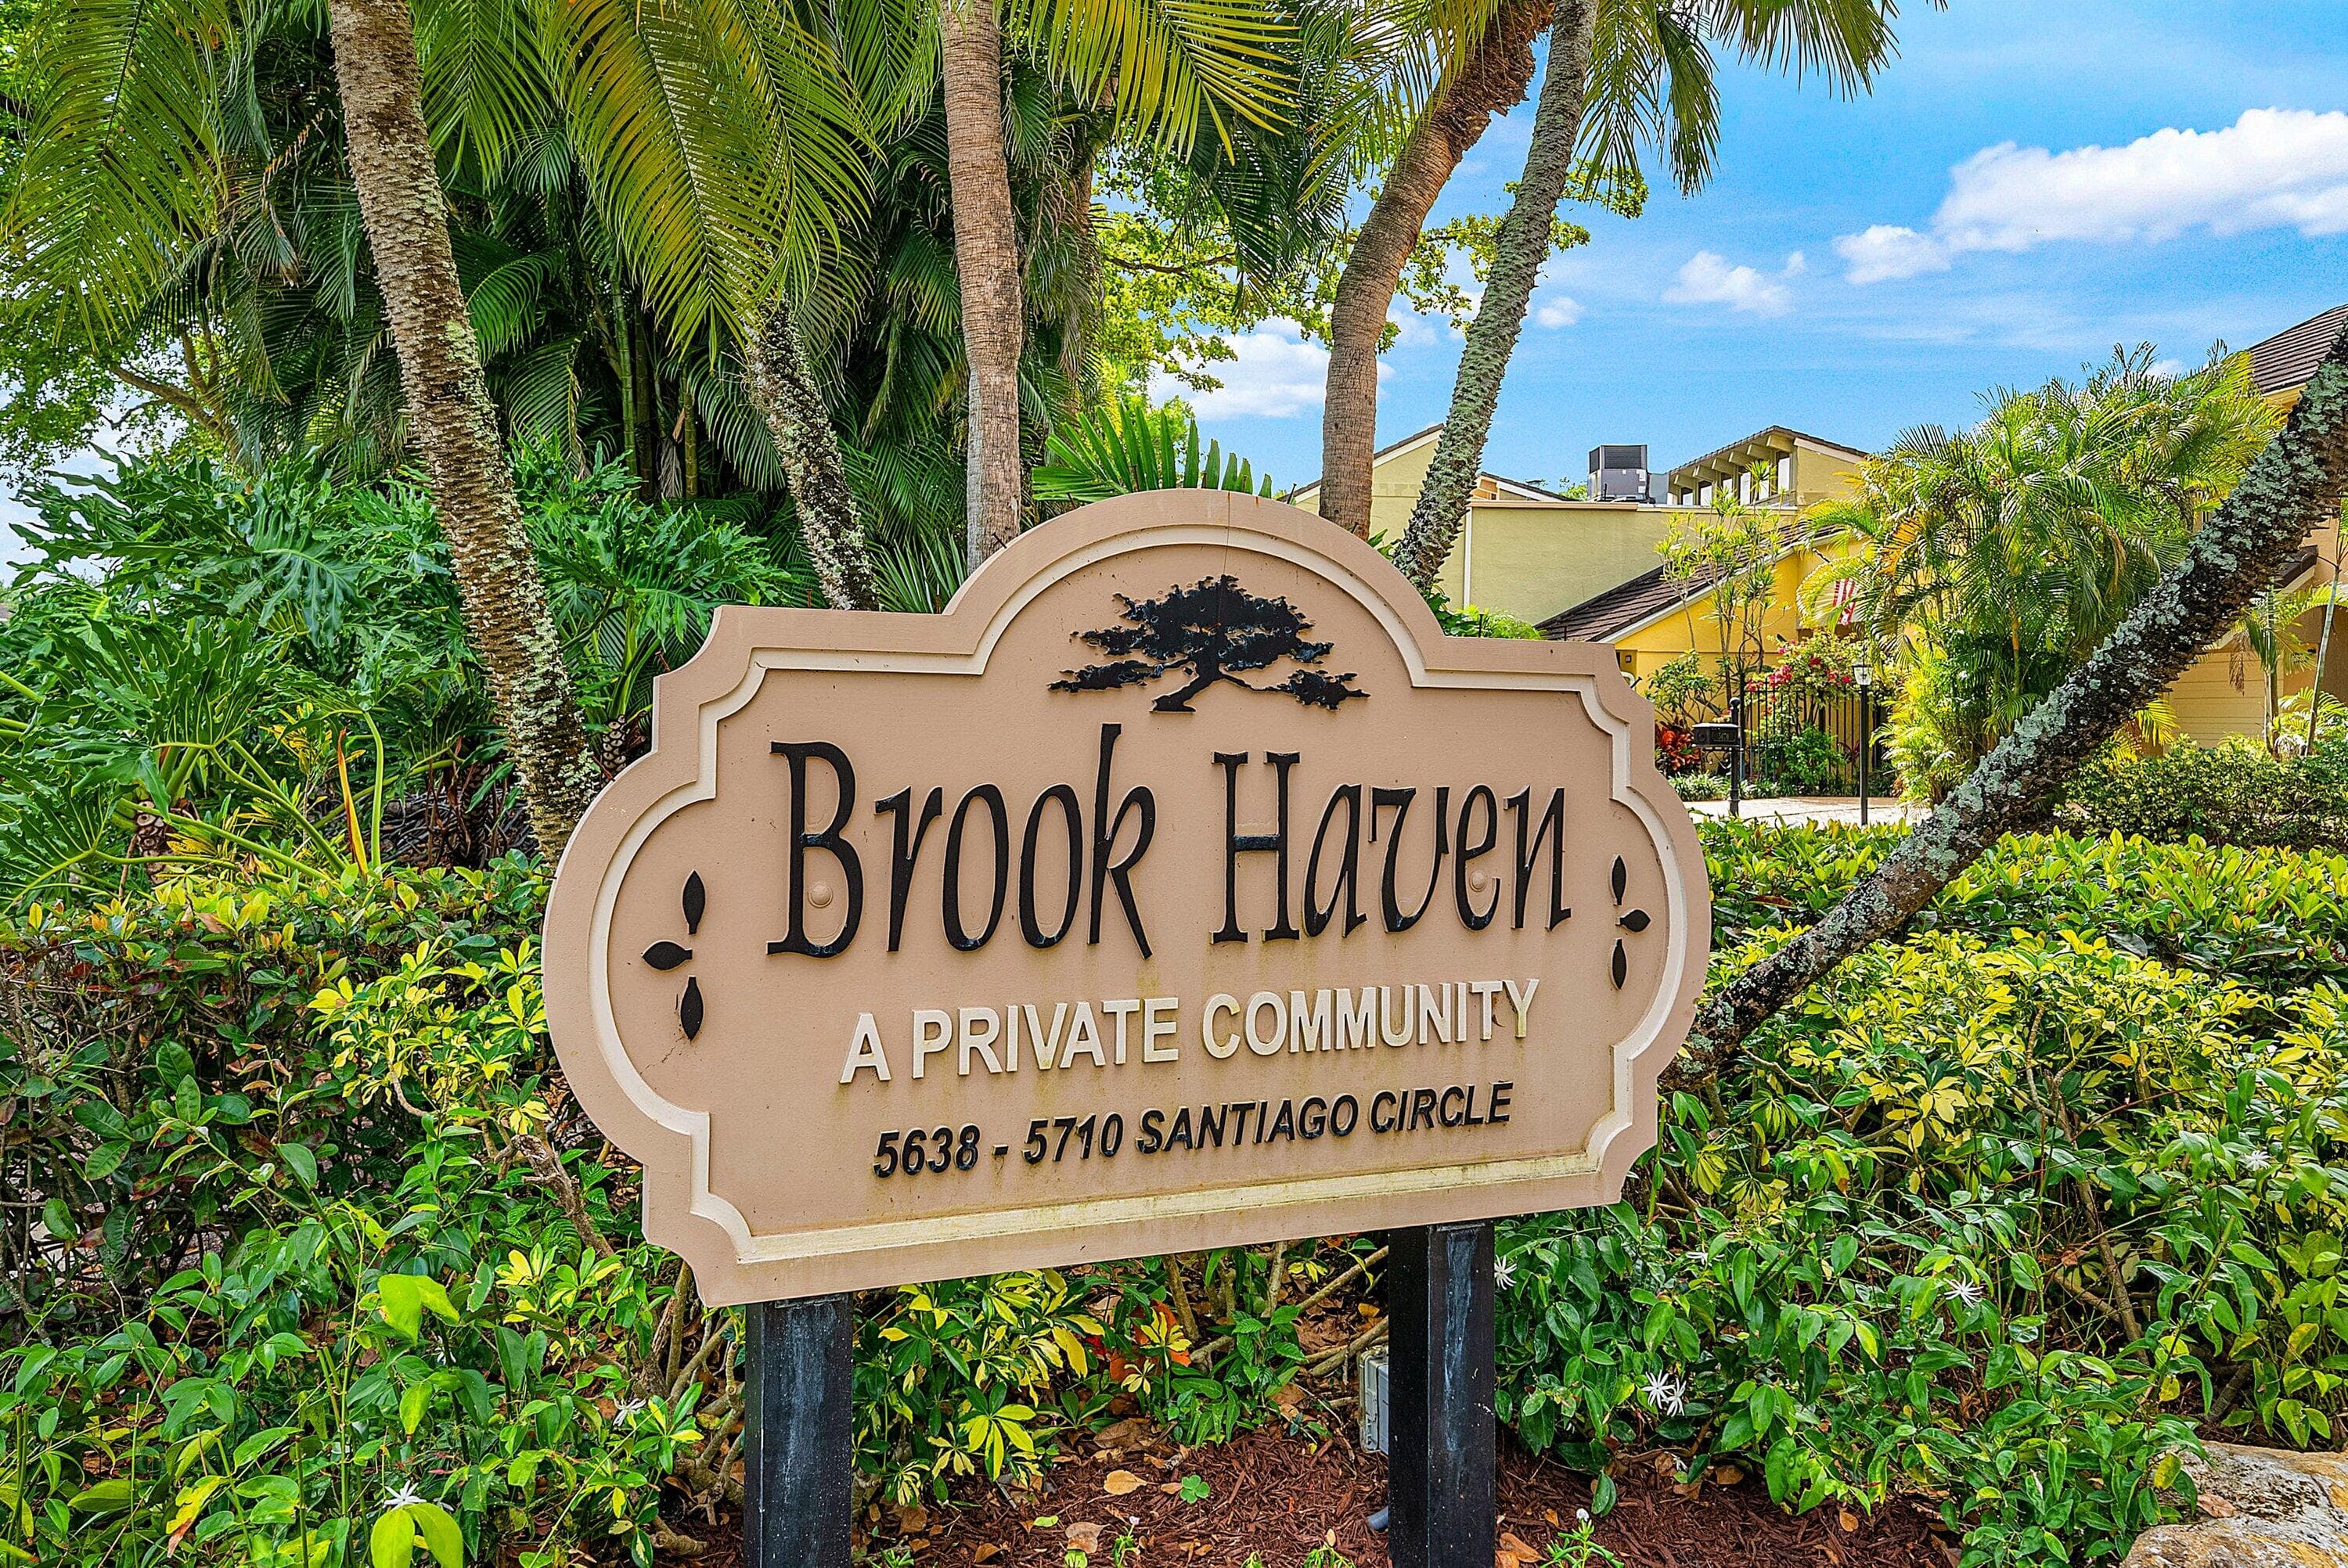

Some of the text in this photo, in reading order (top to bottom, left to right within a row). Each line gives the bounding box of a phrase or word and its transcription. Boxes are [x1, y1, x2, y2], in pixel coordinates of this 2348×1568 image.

[765, 722, 1572, 961] Brook Haven
[840, 978, 1541, 1084] A PRIVATE COMMUNITY
[873, 1124, 981, 1179] 5638
[1022, 1112, 1124, 1166] 5710
[1136, 1094, 1359, 1155] SANTIAGO
[1369, 1081, 1514, 1135] CIRCLE
